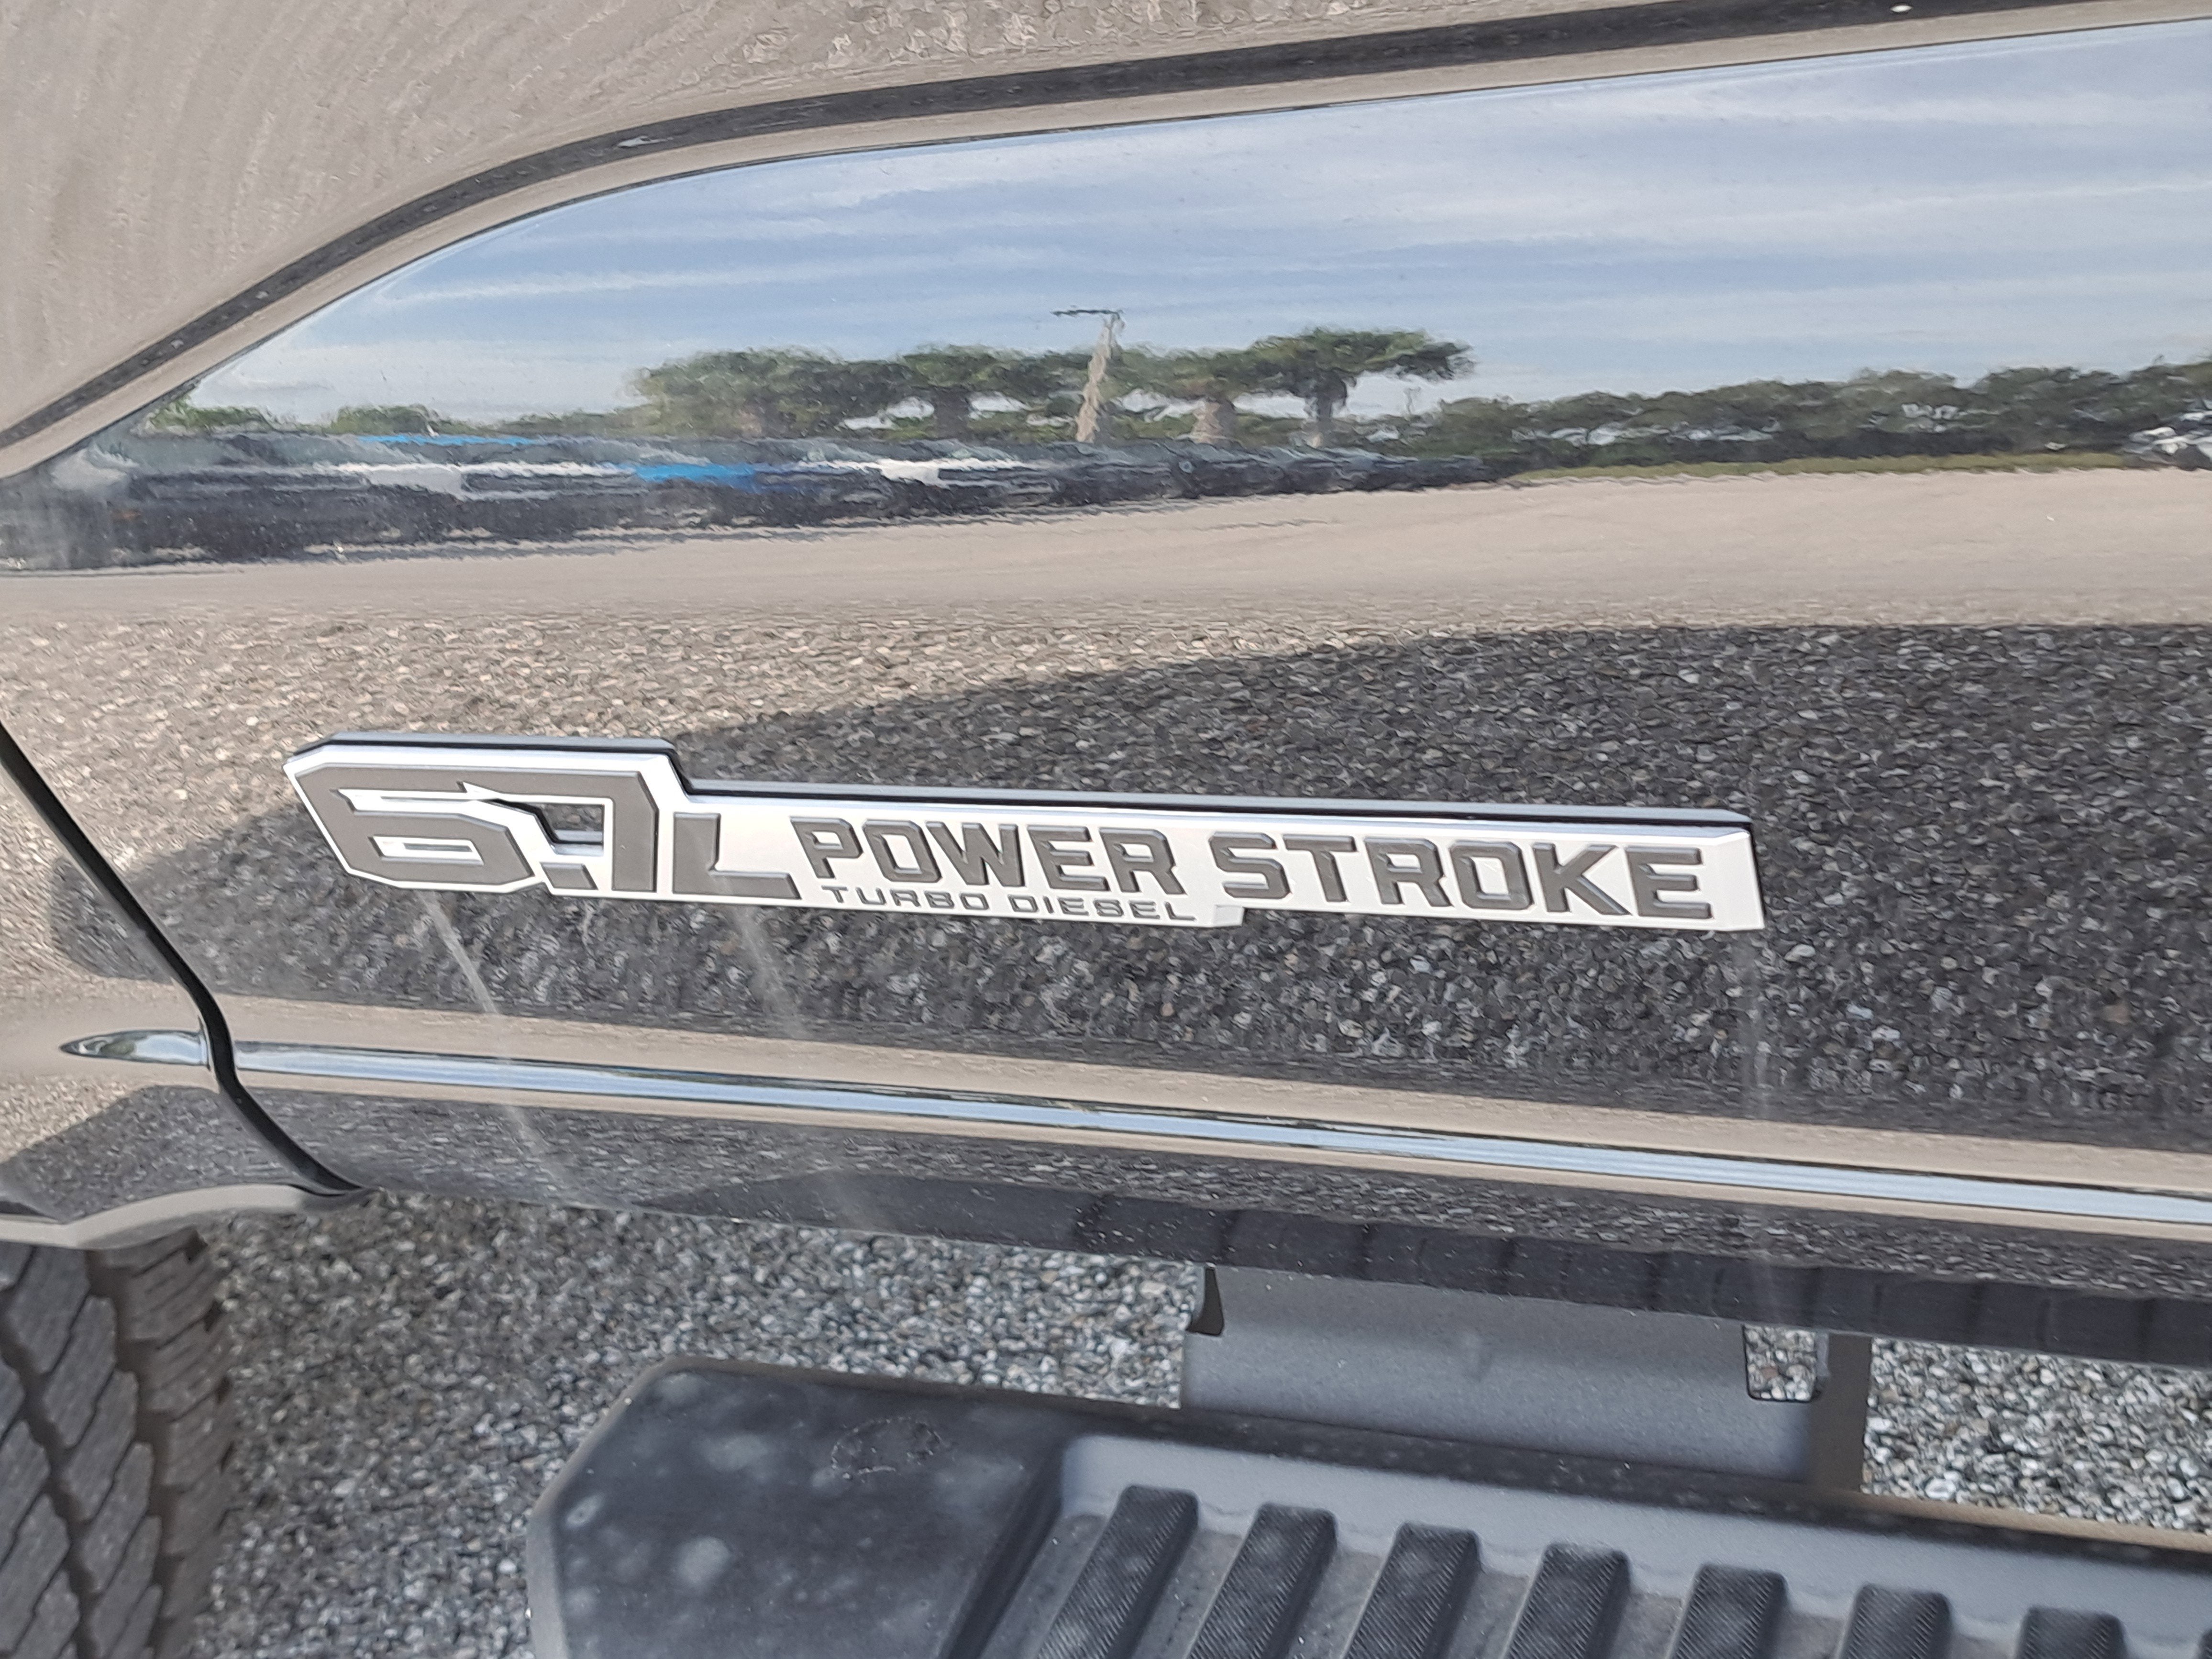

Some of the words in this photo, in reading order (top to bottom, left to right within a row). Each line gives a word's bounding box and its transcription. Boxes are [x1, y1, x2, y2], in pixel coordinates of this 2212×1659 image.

[791, 817, 1188, 895] POWER
[1208, 831, 1714, 919] STROKE
[822, 885, 989, 911] TURBO
[1008, 894, 1196, 921] DIESEL
